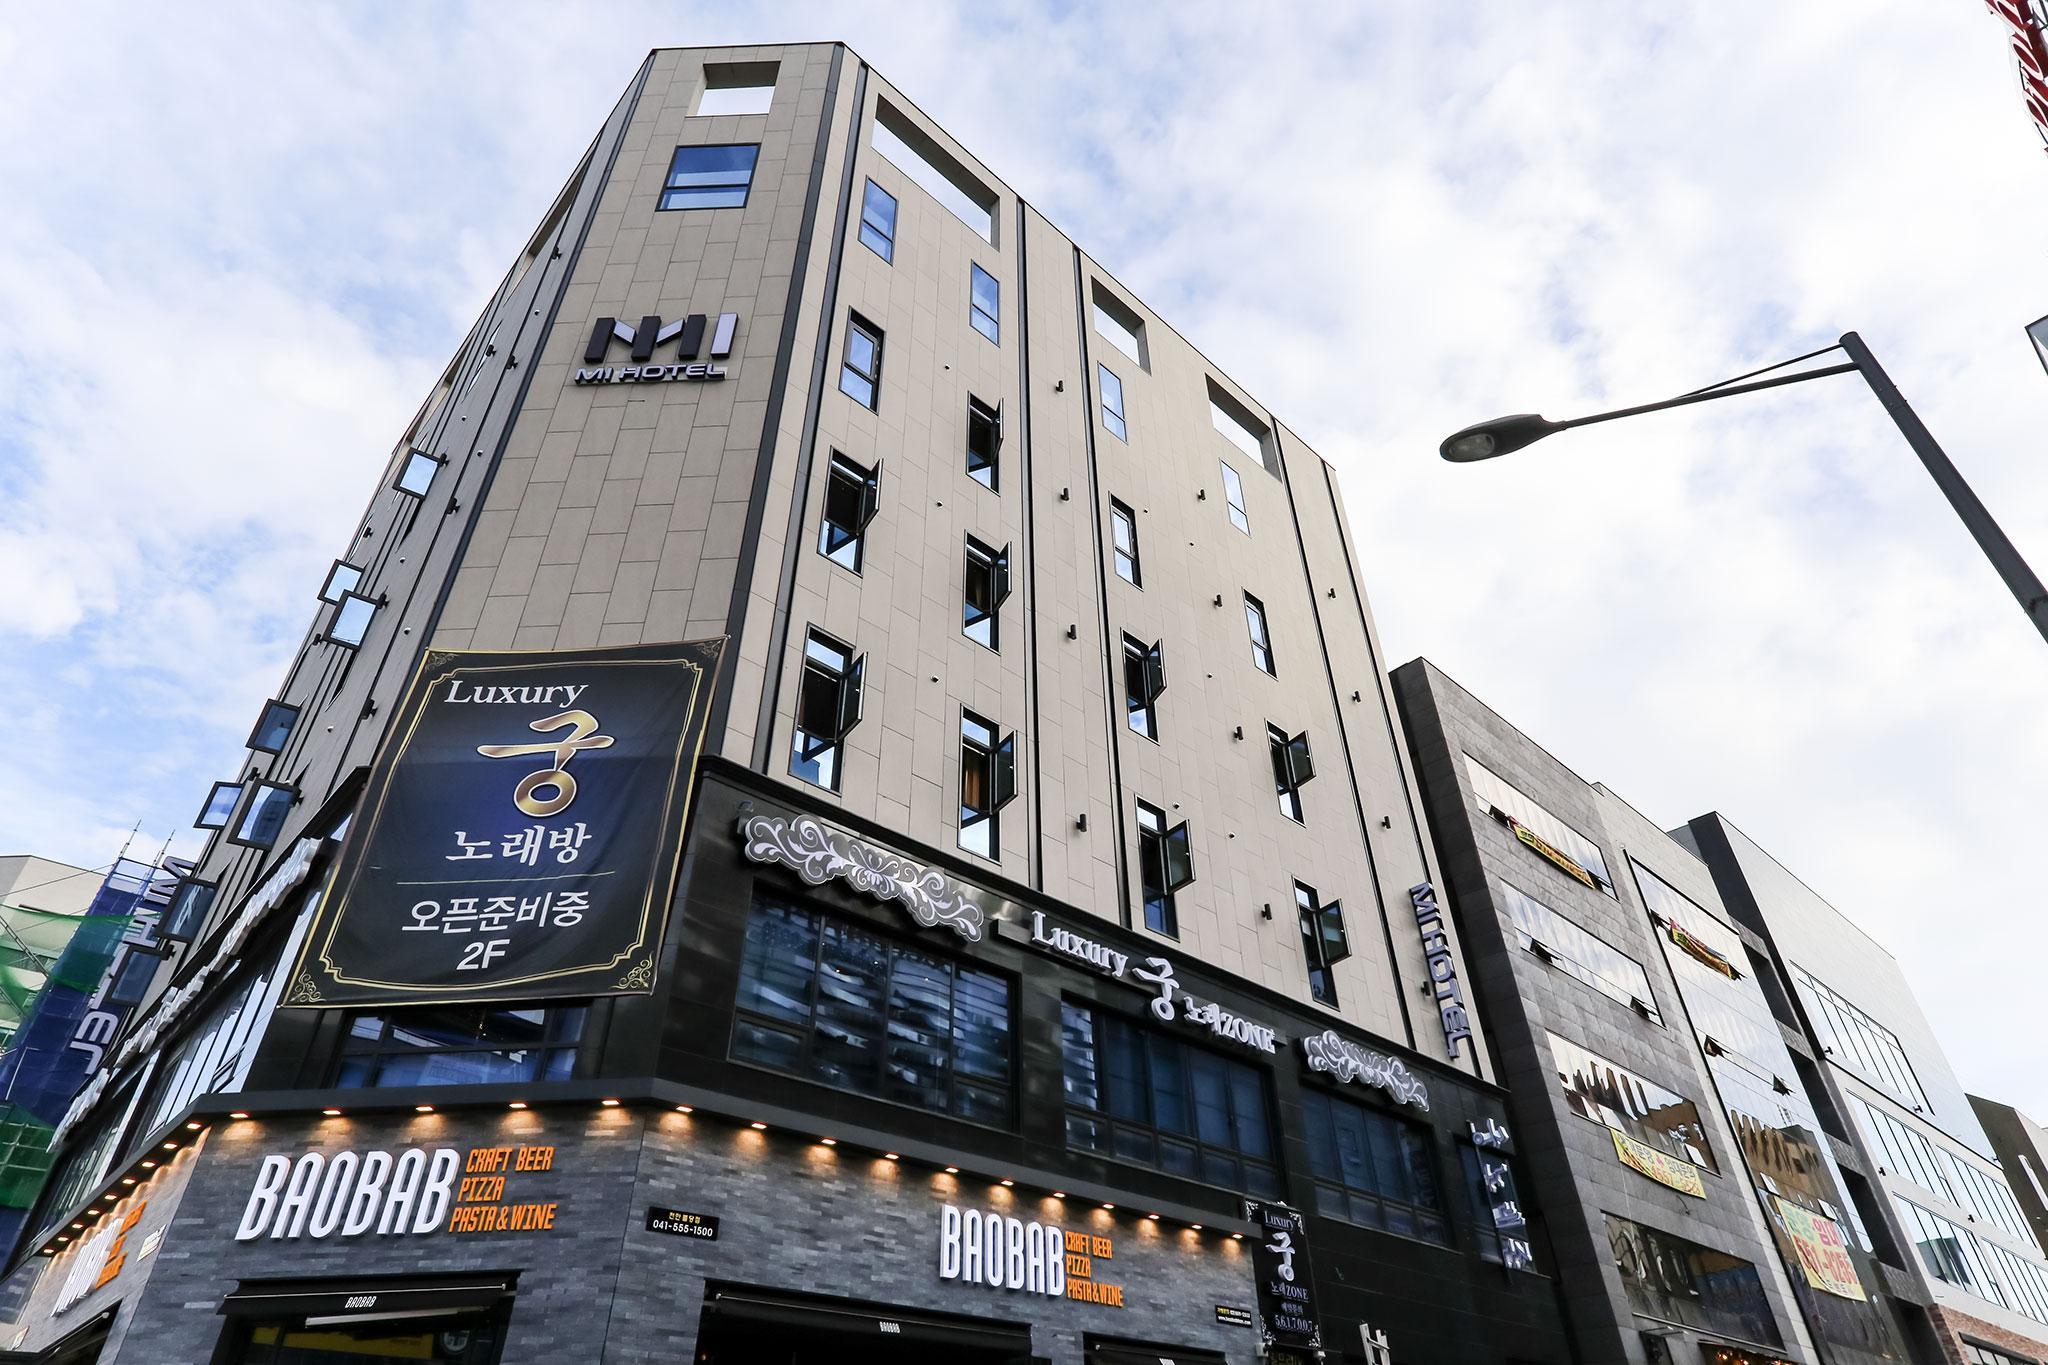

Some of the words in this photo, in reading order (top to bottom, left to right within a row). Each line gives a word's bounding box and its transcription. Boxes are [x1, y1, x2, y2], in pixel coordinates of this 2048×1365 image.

[575, 367, 614, 384] MI
[618, 363, 726, 383] HOTEL
[444, 680, 589, 708] Luxury
[476, 709, 615, 818] 궁
[445, 823, 592, 866] 노래방
[402, 891, 590, 934] 오픈준비중
[456, 939, 510, 970] 2F
[1031, 910, 1129, 978] Luxury
[1422, 926, 1472, 1059] HOTEL
[465, 1148, 514, 1173] CRAFT
[515, 1146, 555, 1172] BEER
[234, 1148, 460, 1241] BAOBAB
[457, 1176, 506, 1202] PIZZA
[653, 1219, 713, 1237] 041-555-1500
[1264, 1211, 1294, 1232] Luxury
[939, 1204, 1065, 1297] BAOBAB
[1065, 1230, 1090, 1255] CRAFT
[1092, 1235, 1113, 1259] BEER
[1066, 1253, 1092, 1278] PIZZA
[345, 1296, 376, 1309] BAOBAB
